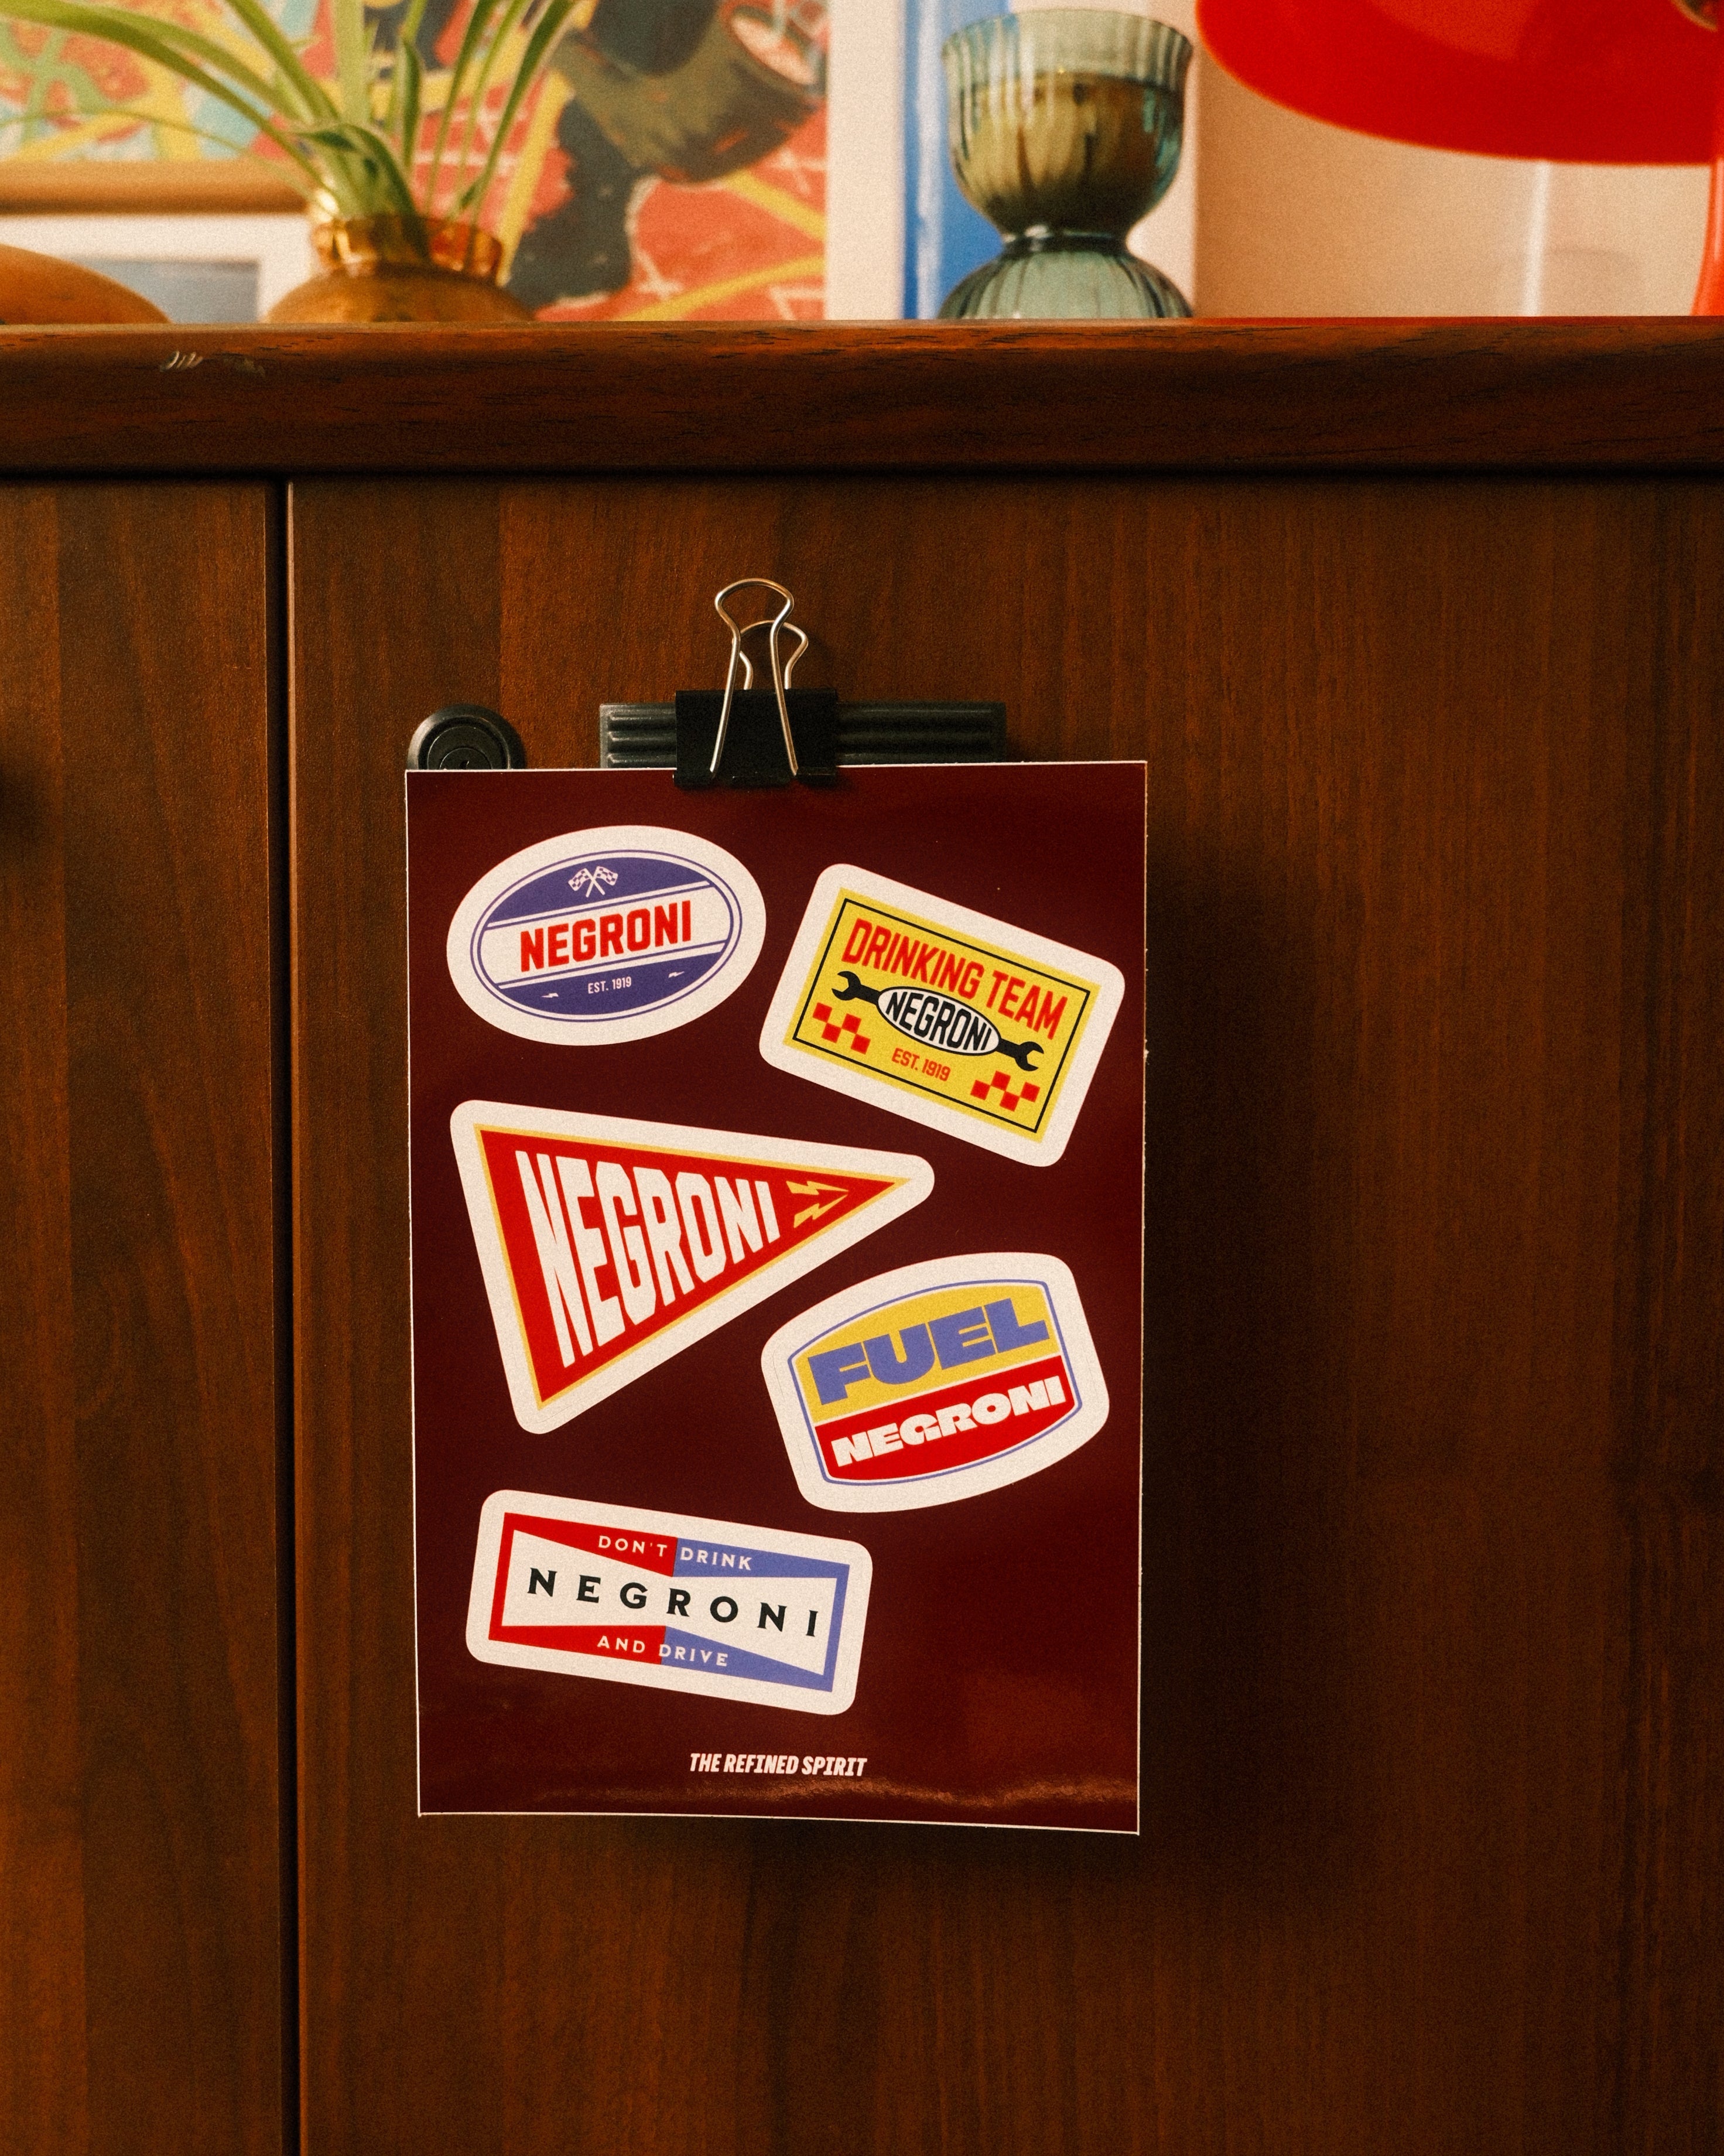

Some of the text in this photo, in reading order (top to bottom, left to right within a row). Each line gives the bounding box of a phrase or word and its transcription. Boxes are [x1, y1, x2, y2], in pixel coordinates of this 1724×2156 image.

[520, 900, 692, 973] NEGRONI
[587, 976, 632, 995] EST. 1919
[842, 918, 1069, 1040] DRINKING TEAM
[885, 991, 992, 1051] NEGRONI
[891, 1047, 951, 1081] EST. 1919
[515, 1150, 781, 1369] NEGRONI
[808, 1297, 1051, 1406] FUEL
[830, 1375, 1066, 1468] NEGRONI
[598, 1535, 753, 1571] DON'T DRINK
[526, 1567, 819, 1638] NEGRONI
[597, 1635, 729, 1668] AND DRIVE
[689, 1752, 868, 1777] THE REFINED SPIRIT
